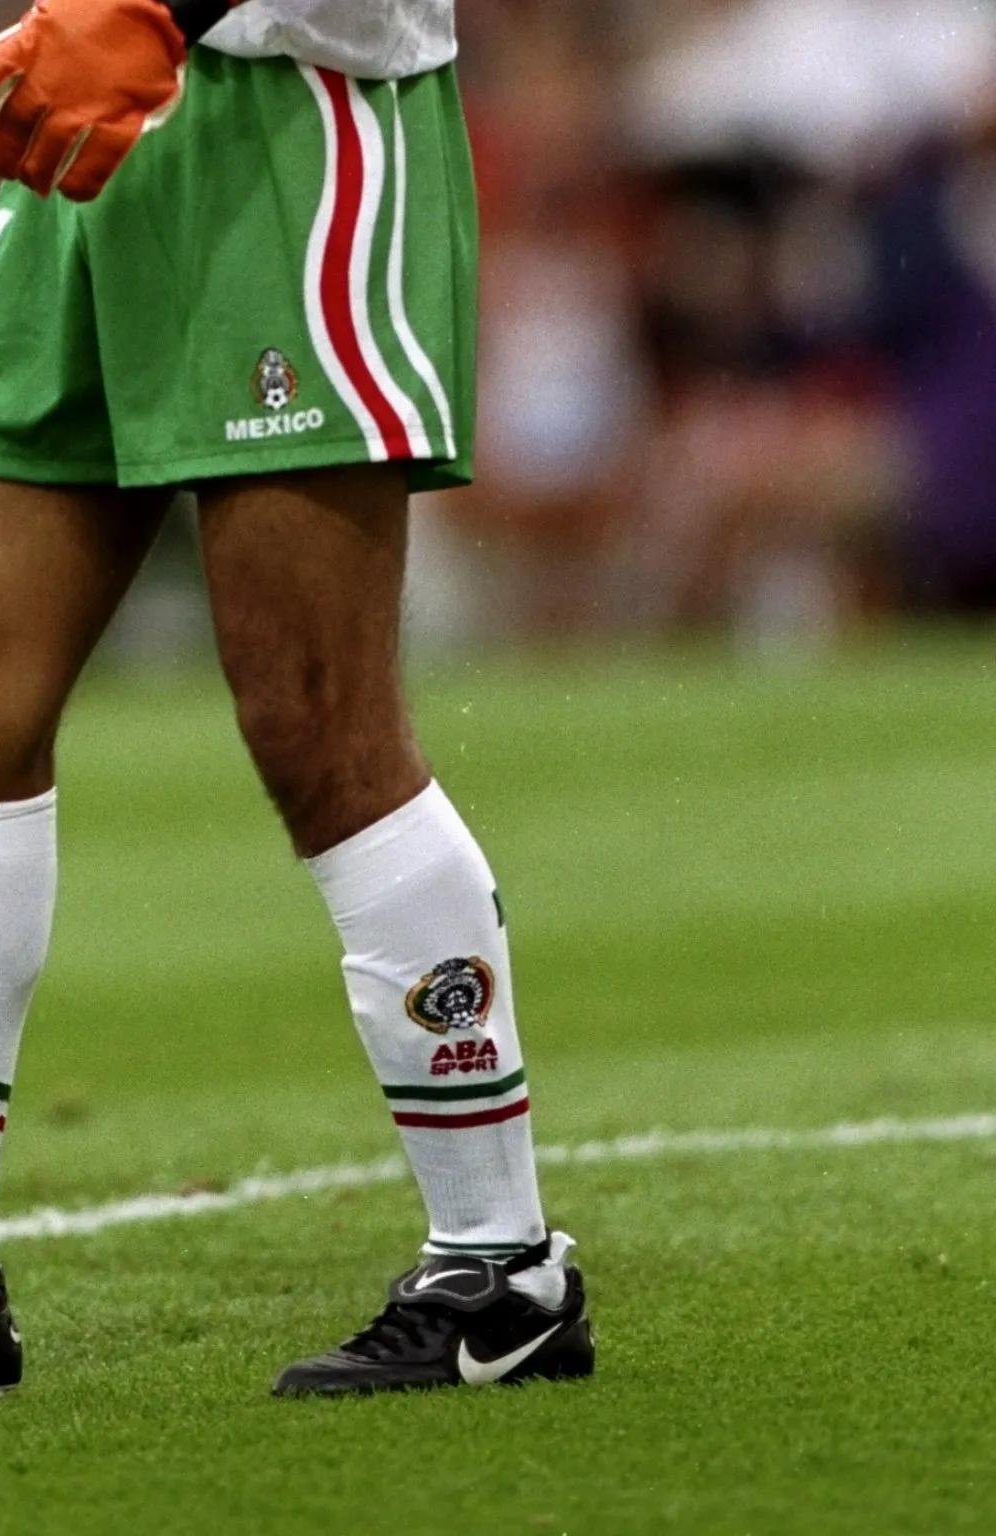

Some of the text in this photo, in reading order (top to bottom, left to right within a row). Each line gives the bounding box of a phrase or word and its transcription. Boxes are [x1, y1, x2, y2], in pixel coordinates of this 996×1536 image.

[224, 407, 324, 441] MEXICO
[431, 1037, 499, 1063] ABA
[430, 1057, 499, 1076] SPORT
